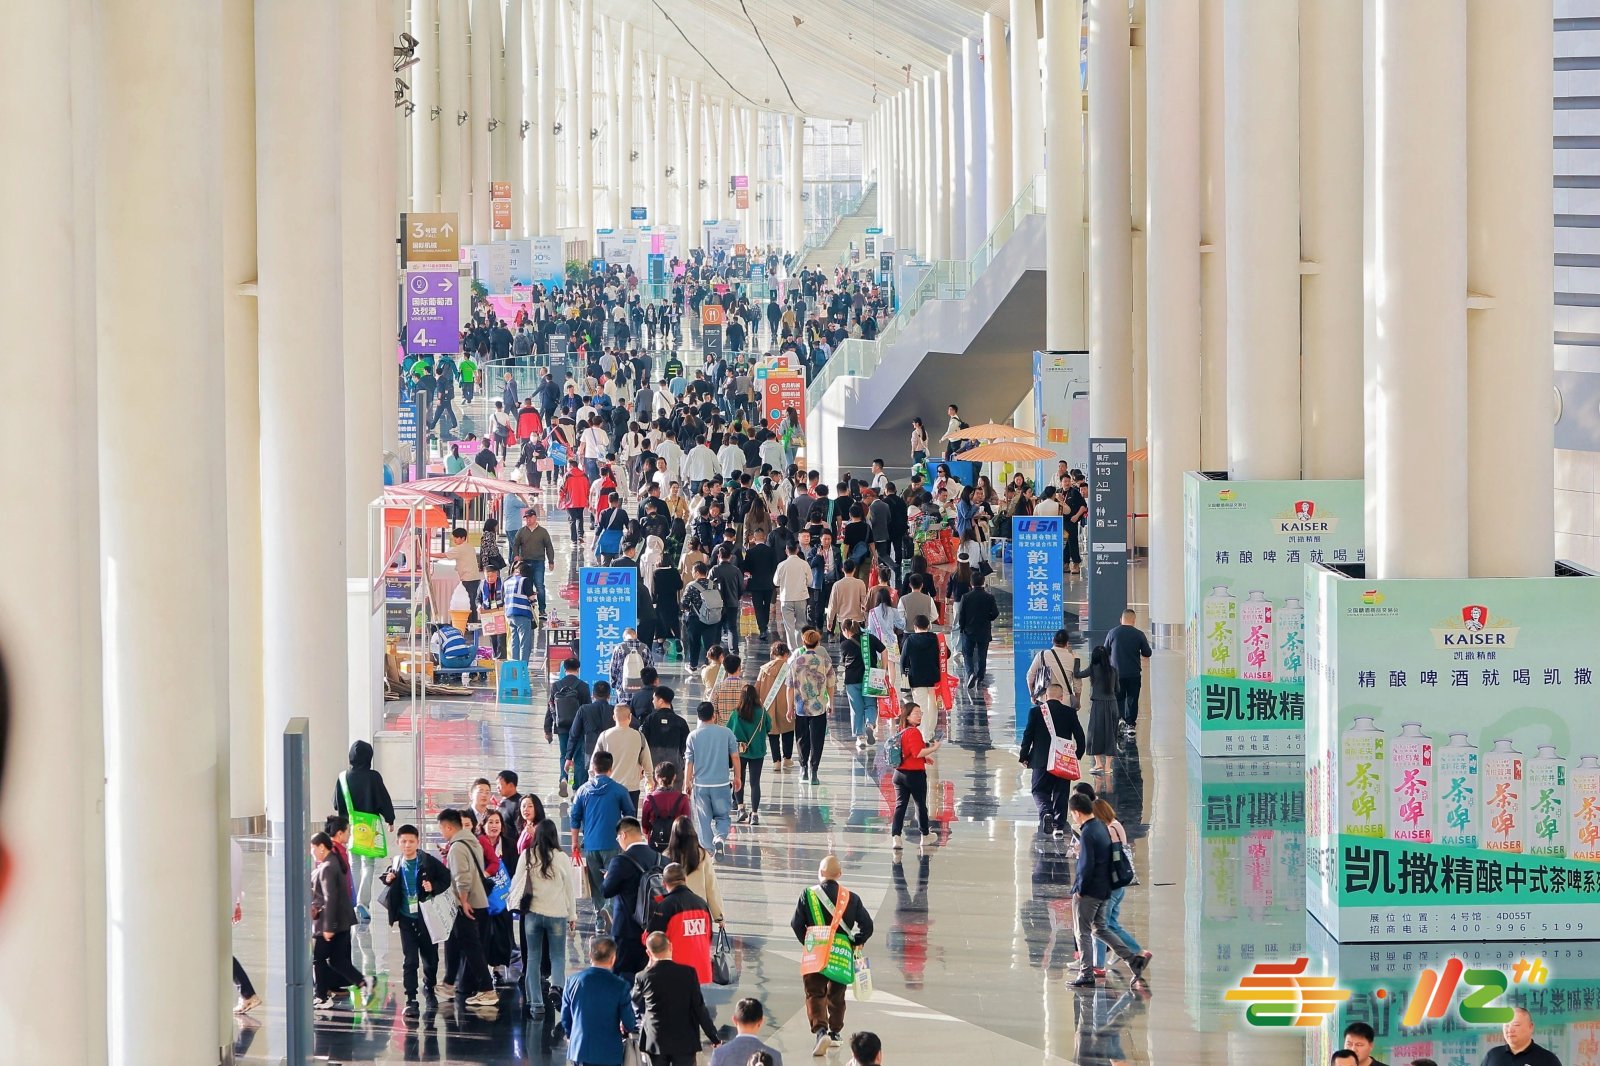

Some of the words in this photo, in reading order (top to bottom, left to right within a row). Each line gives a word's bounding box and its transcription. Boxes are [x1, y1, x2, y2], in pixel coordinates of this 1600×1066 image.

[412, 222, 424, 238] 3
[412, 298, 452, 306] 国际葡萄酒
[412, 307, 436, 315] 及烈酒
[413, 328, 428, 346] 4
[1281, 522, 1328, 531] KAISER
[1096, 566, 1102, 575] 4
[1027, 550, 1048, 611] 韵达快递
[1444, 633, 1506, 645] KAISER
[1243, 671, 1272, 679] KAISER
[1358, 667, 1593, 688] 精酿啤酒就喝凯撒
[1207, 684, 1305, 721] 凯撒精
[1346, 762, 1380, 824] 茶啤
[1394, 768, 1428, 830] 茶啤
[1441, 777, 1474, 834] 茶啤
[1486, 782, 1518, 840] 茶啤
[1530, 788, 1561, 845] 茶啤
[1346, 824, 1383, 833] KAISER
[1394, 830, 1431, 838] KAISER
[1441, 835, 1477, 844] KAISER
[1486, 840, 1521, 849] KAISER
[1530, 845, 1565, 854] KAISER
